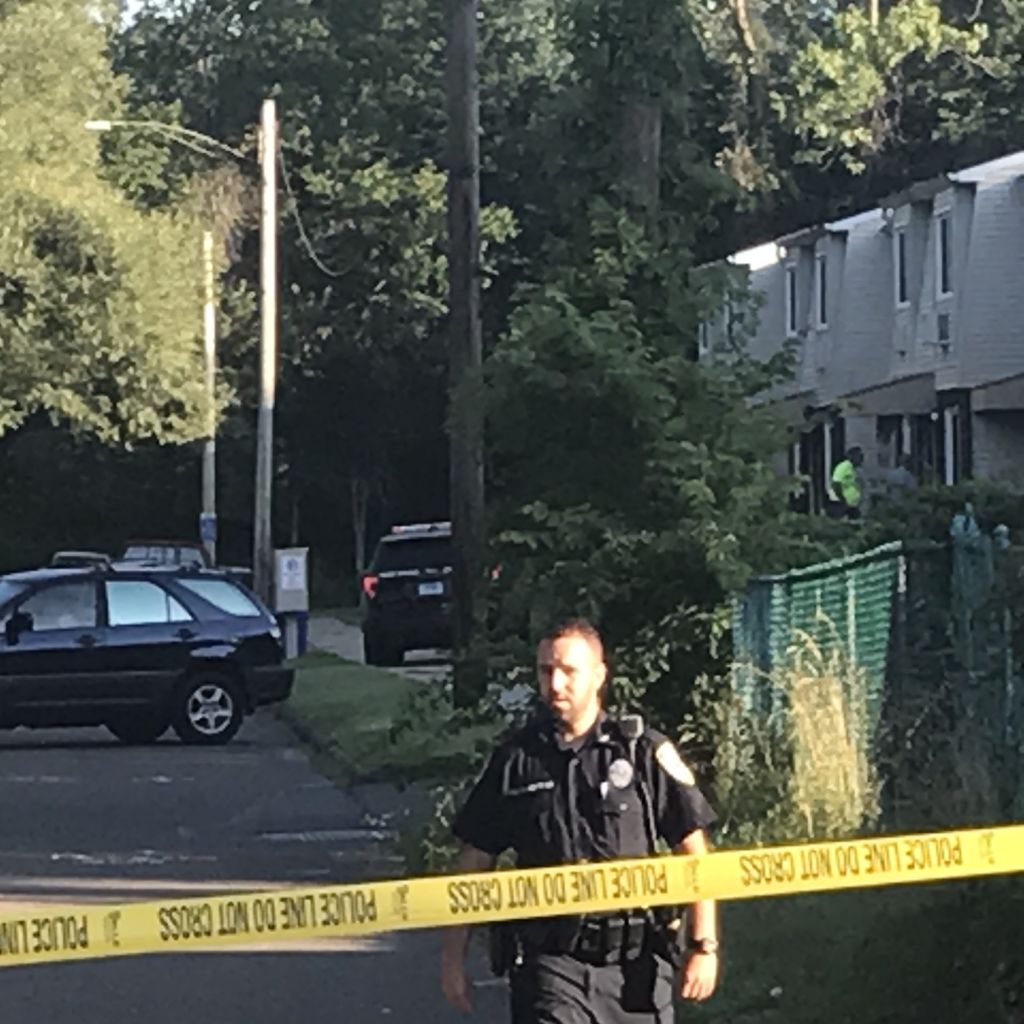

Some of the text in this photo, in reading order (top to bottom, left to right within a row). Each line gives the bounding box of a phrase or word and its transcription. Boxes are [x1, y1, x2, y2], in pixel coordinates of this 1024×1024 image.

[739, 836, 963, 886] POLICE LINE DO NOT CROSS
[448, 863, 667, 914] POLICE LINE DO NOT CROSS
[32, 915, 88, 953] POLICE
[158, 889, 376, 941] POLICE LINE DO NOT CROSS
